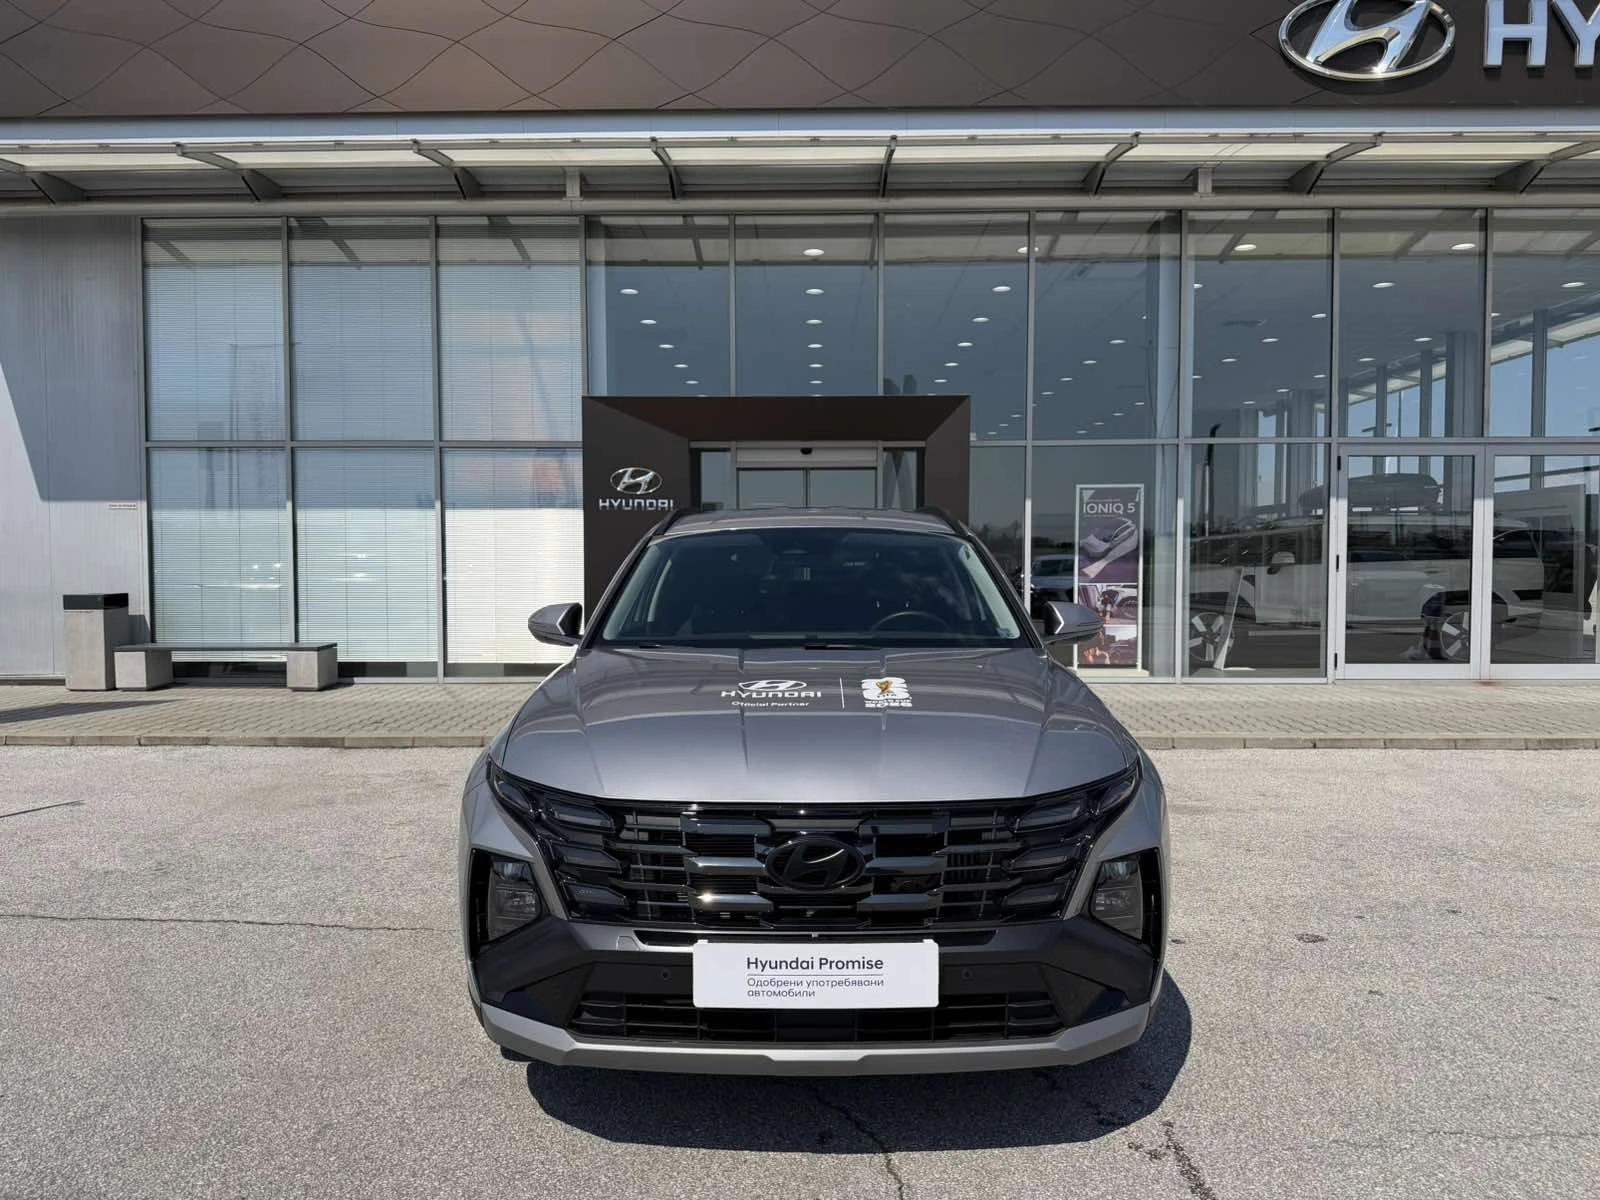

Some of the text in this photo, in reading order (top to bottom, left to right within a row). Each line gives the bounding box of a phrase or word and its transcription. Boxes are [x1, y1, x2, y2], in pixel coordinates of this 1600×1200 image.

[598, 499, 674, 511] HYUNDAI
[1083, 502, 1136, 515] IONIQ 5
[720, 689, 822, 698] HYUNDAI
[746, 956, 884, 973] Hyundai Promise
[747, 977, 884, 989] Одобрени употребявани
[747, 988, 816, 997] автомобили
